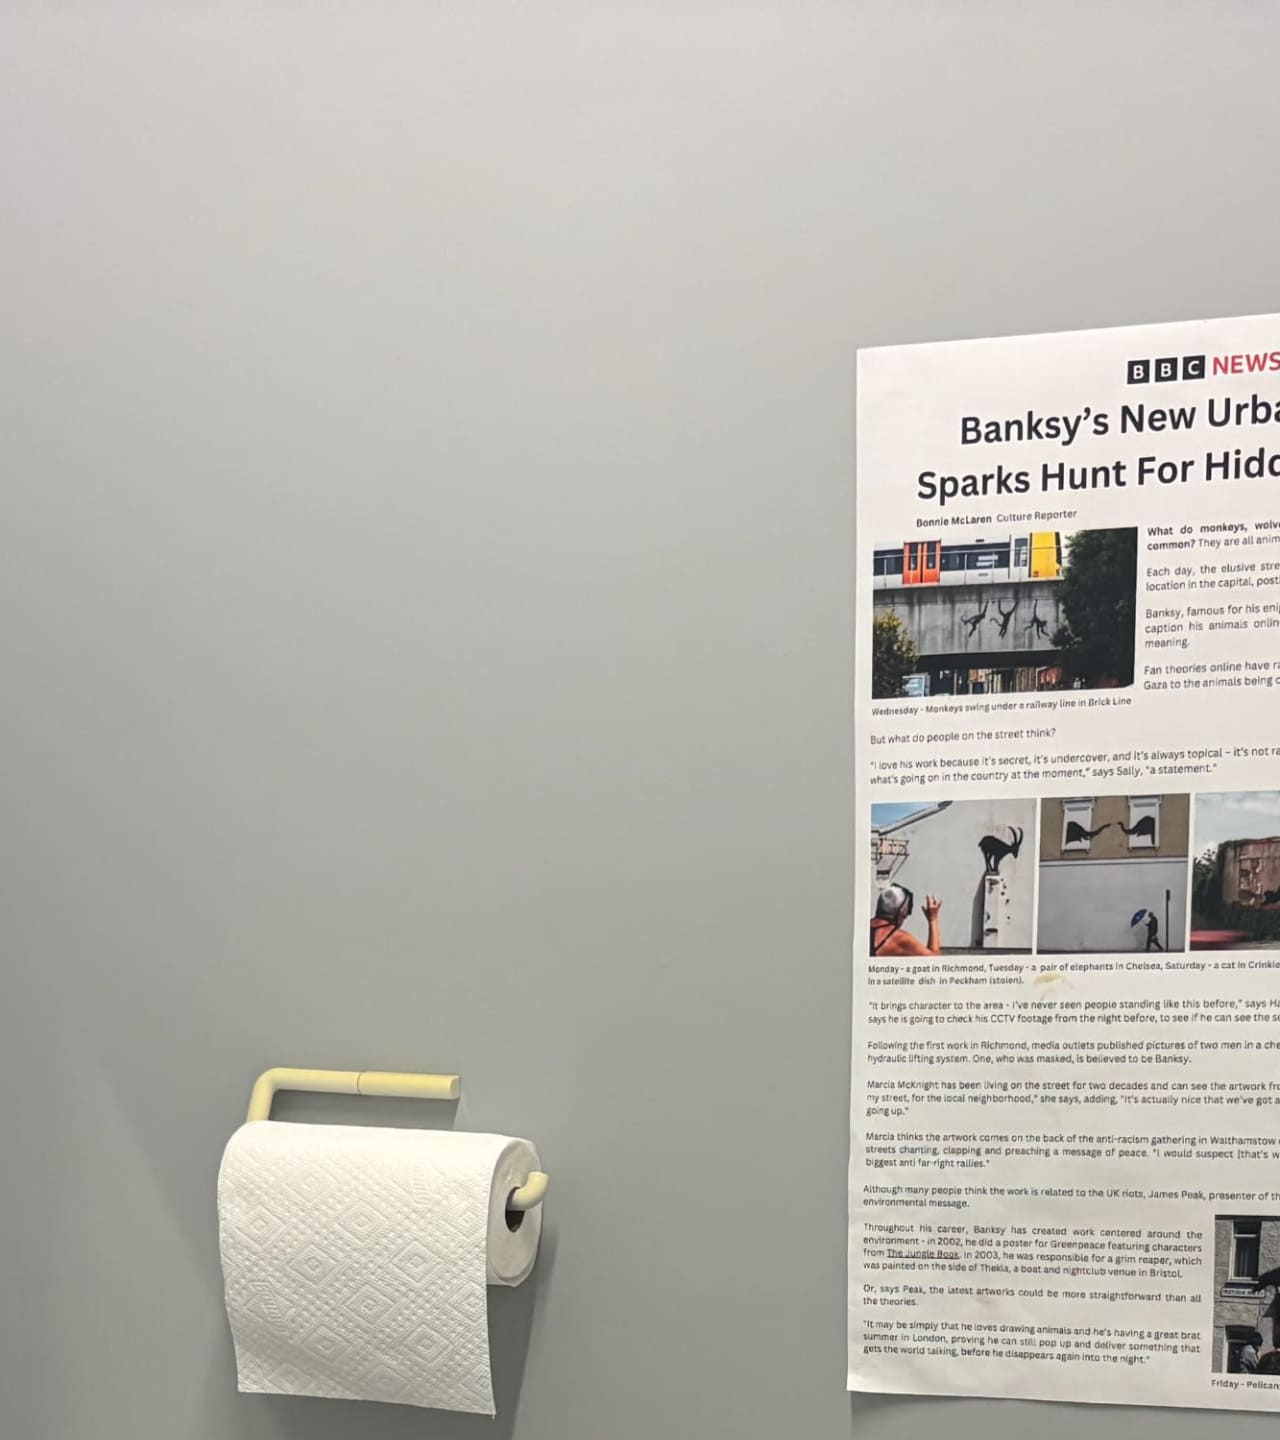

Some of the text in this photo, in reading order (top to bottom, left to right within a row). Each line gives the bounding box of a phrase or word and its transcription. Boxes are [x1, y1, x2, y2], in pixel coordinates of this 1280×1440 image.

[1120, 403, 1197, 435] New
[917, 464, 1031, 507] Sparks
[1041, 460, 1128, 493] Hunt
[1137, 455, 1196, 486] For
[915, 509, 1078, 529] Bonnie McLaren Culture Reporter
[1147, 526, 1174, 537] What
[1179, 524, 1194, 535] do
[1199, 522, 1249, 535] monkeys,
[1146, 538, 1197, 552] common?
[1197, 537, 1222, 550] They
[1223, 537, 1241, 547] are
[1241, 534, 1255, 546] all
[1145, 566, 1171, 578] Each
[1173, 565, 1196, 578] day,
[1199, 564, 1218, 575] the
[1220, 562, 1257, 574] elusive
[1145, 579, 1187, 593] location
[1187, 579, 1198, 590] in
[1198, 579, 1217, 589] the
[1217, 575, 1255, 590] capital,
[869, 734, 887, 746] But
[887, 733, 911, 745] what
[911, 732, 926, 744] do
[925, 731, 961, 745] people
[961, 732, 975, 742] on
[975, 730, 994, 741] the
[994, 729, 1025, 741] street
[899, 774, 927, 787] going
[926, 773, 940, 784] on
[941, 771, 951, 782] in
[952, 771, 970, 783] the
[969, 771, 1009, 783] country
[1010, 770, 1022, 780] at
[1022, 769, 1041, 780] the
[1091, 767, 1116, 780] says
[866, 1053, 908, 1066] hydraulic
[907, 1053, 936, 1066] lifting
[995, 1053, 1016, 1064] who
[1016, 1055, 1036, 1064] was
[1075, 1053, 1085, 1064] is
[1085, 1053, 1127, 1064] believed
[1127, 1054, 1140, 1065] to
[1140, 1054, 1154, 1064] be
[865, 1157, 898, 1169] biggest
[898, 1157, 917, 1168] anti
[917, 1157, 955, 1171] far-right
[862, 1197, 928, 1208] environmental
[863, 1222, 915, 1235] Throughout
[918, 1223, 934, 1234] his
[972, 1224, 1007, 1237] Banksy
[1010, 1225, 1028, 1235] has
[1031, 1226, 1068, 1237] created
[1071, 1227, 1096, 1237] work
[1099, 1228, 1143, 1239] centered
[1146, 1229, 1182, 1240] around
[1185, 1230, 1204, 1241] the
[879, 1285, 901, 1296] says
[928, 1285, 945, 1296] the
[947, 1285, 974, 1296] latest
[975, 1287, 1016, 1297] artworks
[1017, 1288, 1045, 1298] could
[1046, 1288, 1060, 1299] be
[1061, 1290, 1087, 1300] more
[1088, 1290, 1162, 1303] straightforward
[1164, 1293, 1188, 1303] than
[1189, 1293, 1202, 1304] all
[862, 1344, 883, 1355] gets
[882, 1345, 899, 1355] the
[899, 1345, 926, 1356] world
[960, 1346, 991, 1358] before
[991, 1348, 1004, 1359] he
[1004, 1349, 1055, 1361] disappears
[1055, 1352, 1081, 1364] again
[1081, 1352, 1101, 1363] into
[1101, 1353, 1119, 1364] the
[1210, 1378, 1240, 1391] Friday
